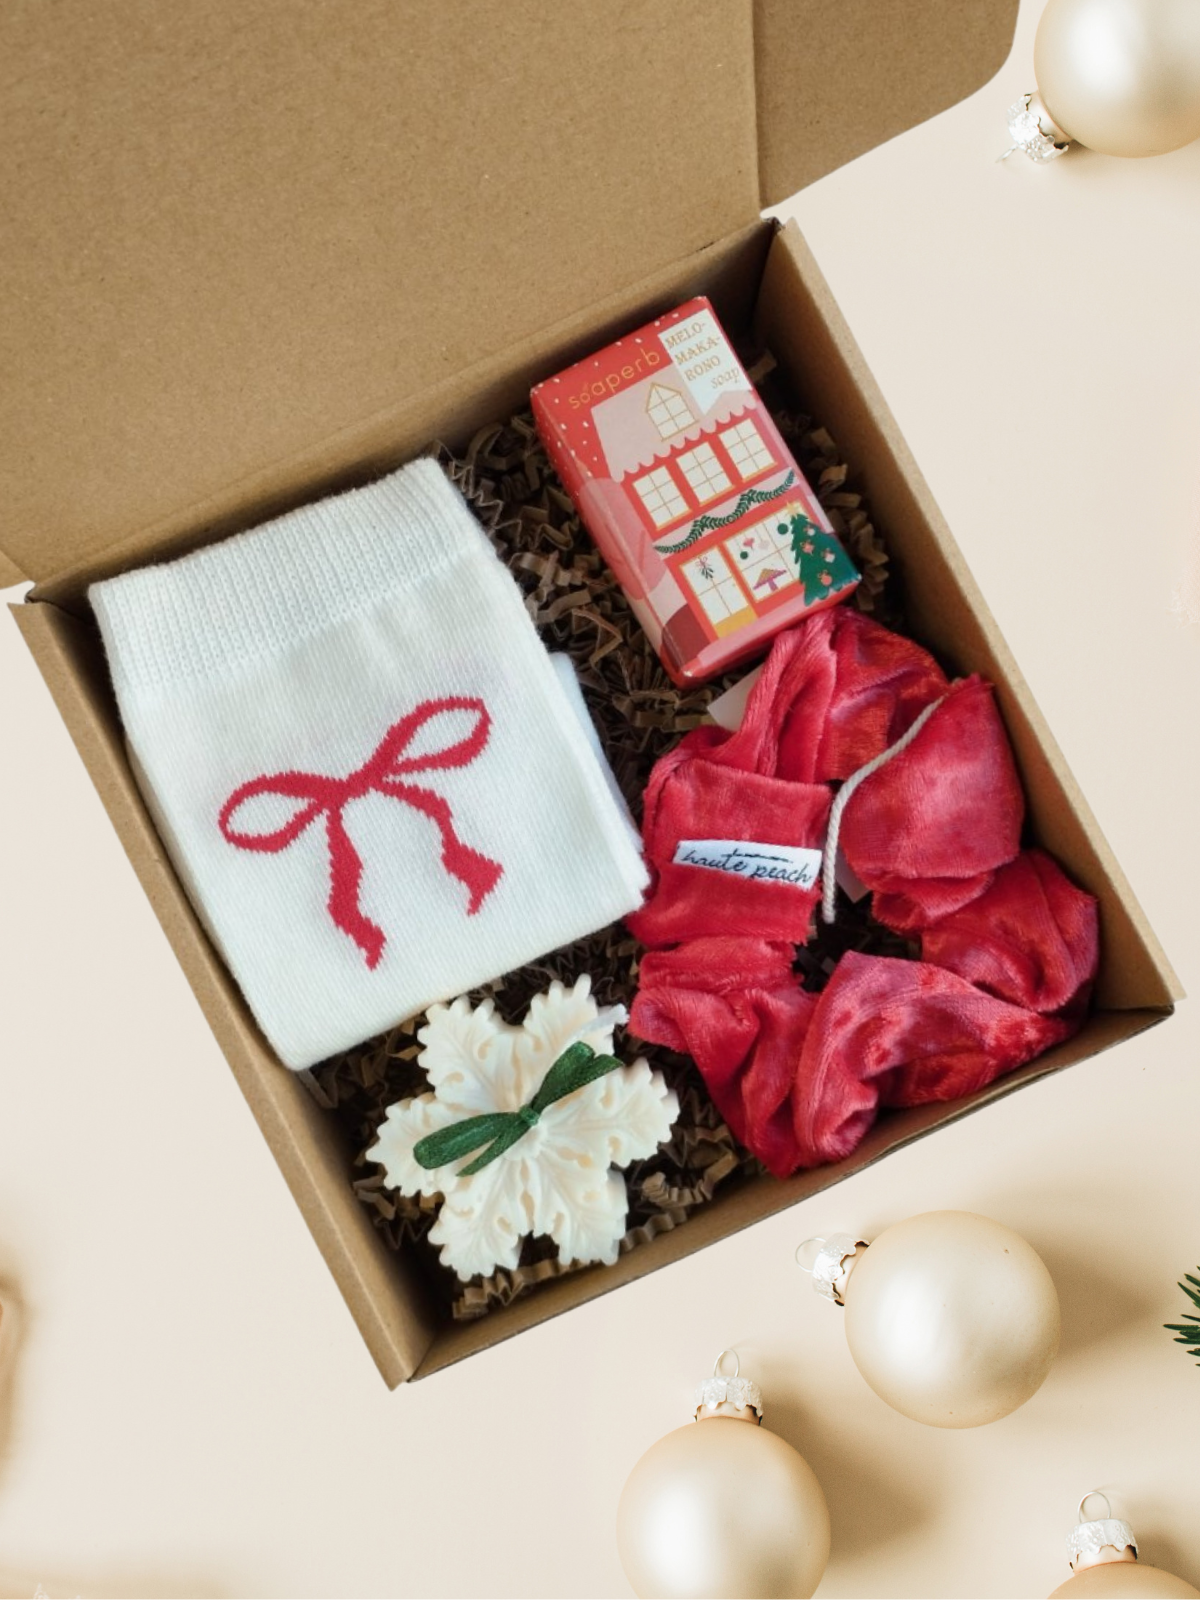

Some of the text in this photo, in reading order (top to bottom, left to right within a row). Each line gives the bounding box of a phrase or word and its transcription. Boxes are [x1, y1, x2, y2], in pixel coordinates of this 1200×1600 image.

[665, 321, 707, 349] MELO-
[674, 335, 721, 366] MAKA-
[568, 347, 661, 409] soaperb
[684, 354, 721, 382] RONO
[711, 367, 741, 390] soap
[681, 848, 812, 884] haute peach
